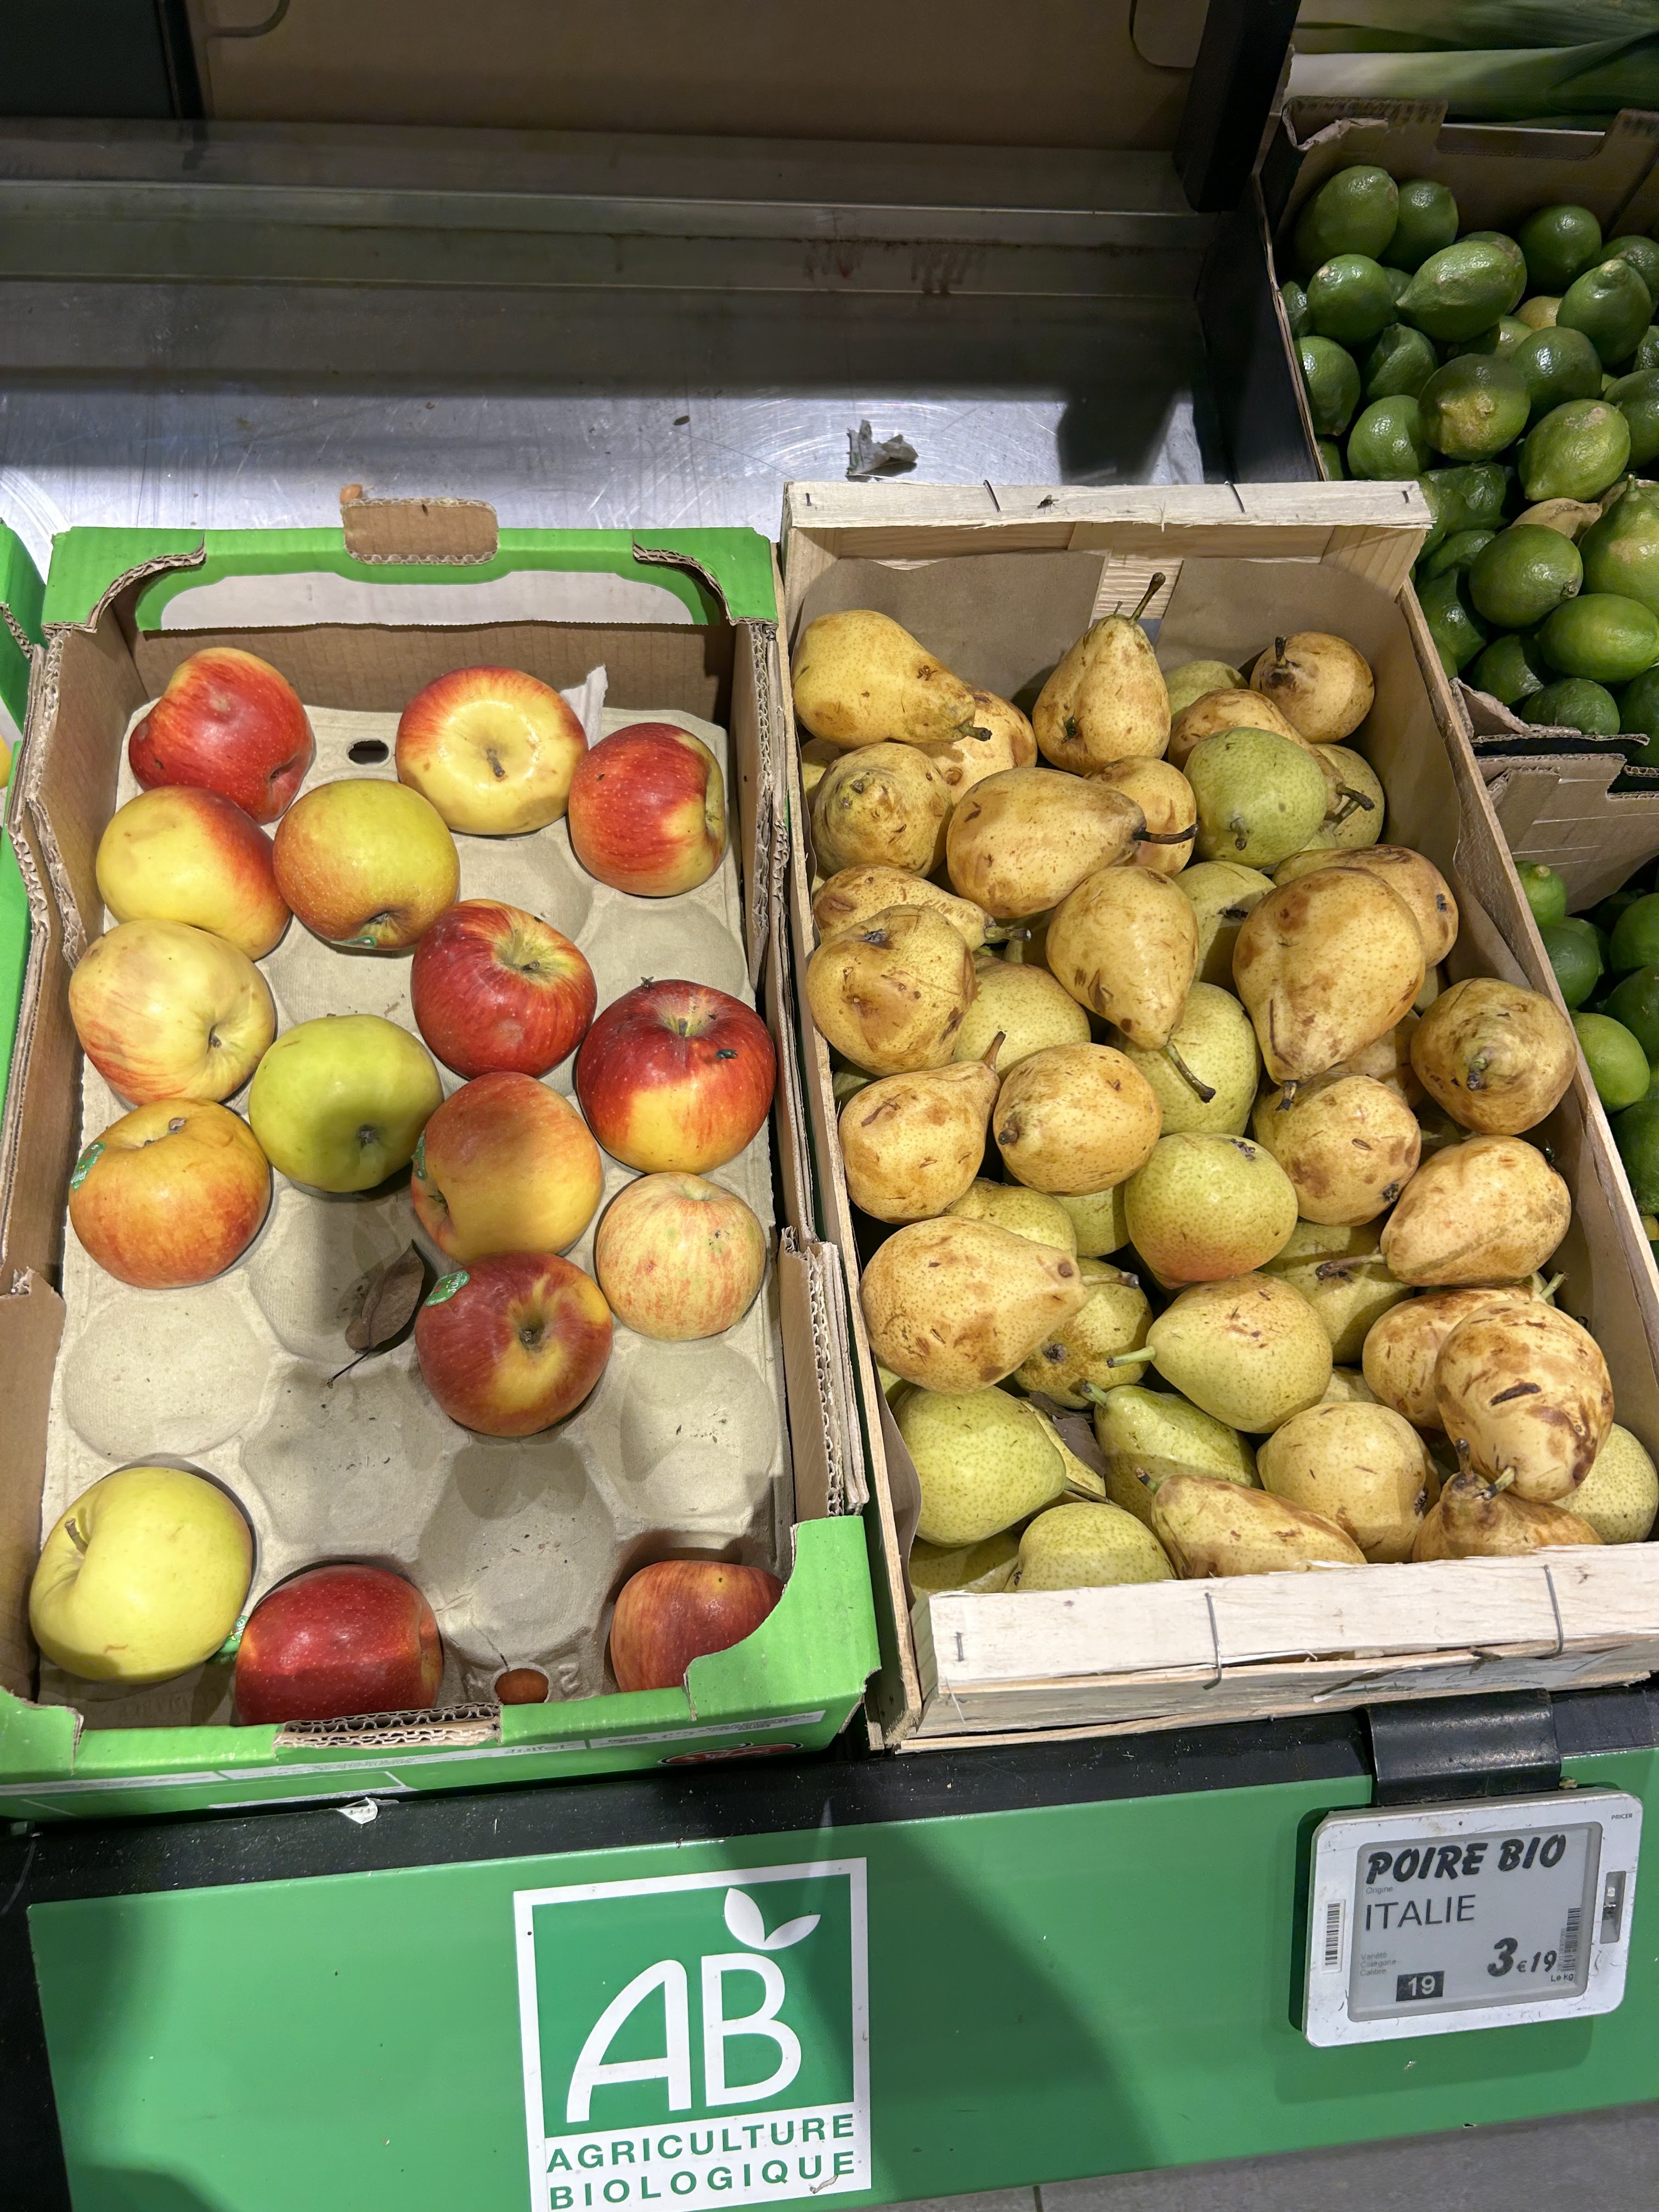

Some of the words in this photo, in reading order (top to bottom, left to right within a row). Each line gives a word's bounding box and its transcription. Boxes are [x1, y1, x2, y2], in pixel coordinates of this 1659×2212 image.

[1365, 1842, 1488, 1885] POIRE
[1497, 1834, 1566, 1872] BIO
[1365, 1894, 1476, 1931] ITALIE
[1366, 1886, 1394, 1895] Origine
[1408, 1975, 1436, 1996] 19
[566, 1953, 802, 2123] AB
[546, 2113, 854, 2173] AGRICULTURE
[550, 2151, 854, 2210] BIOLOGIQUE
